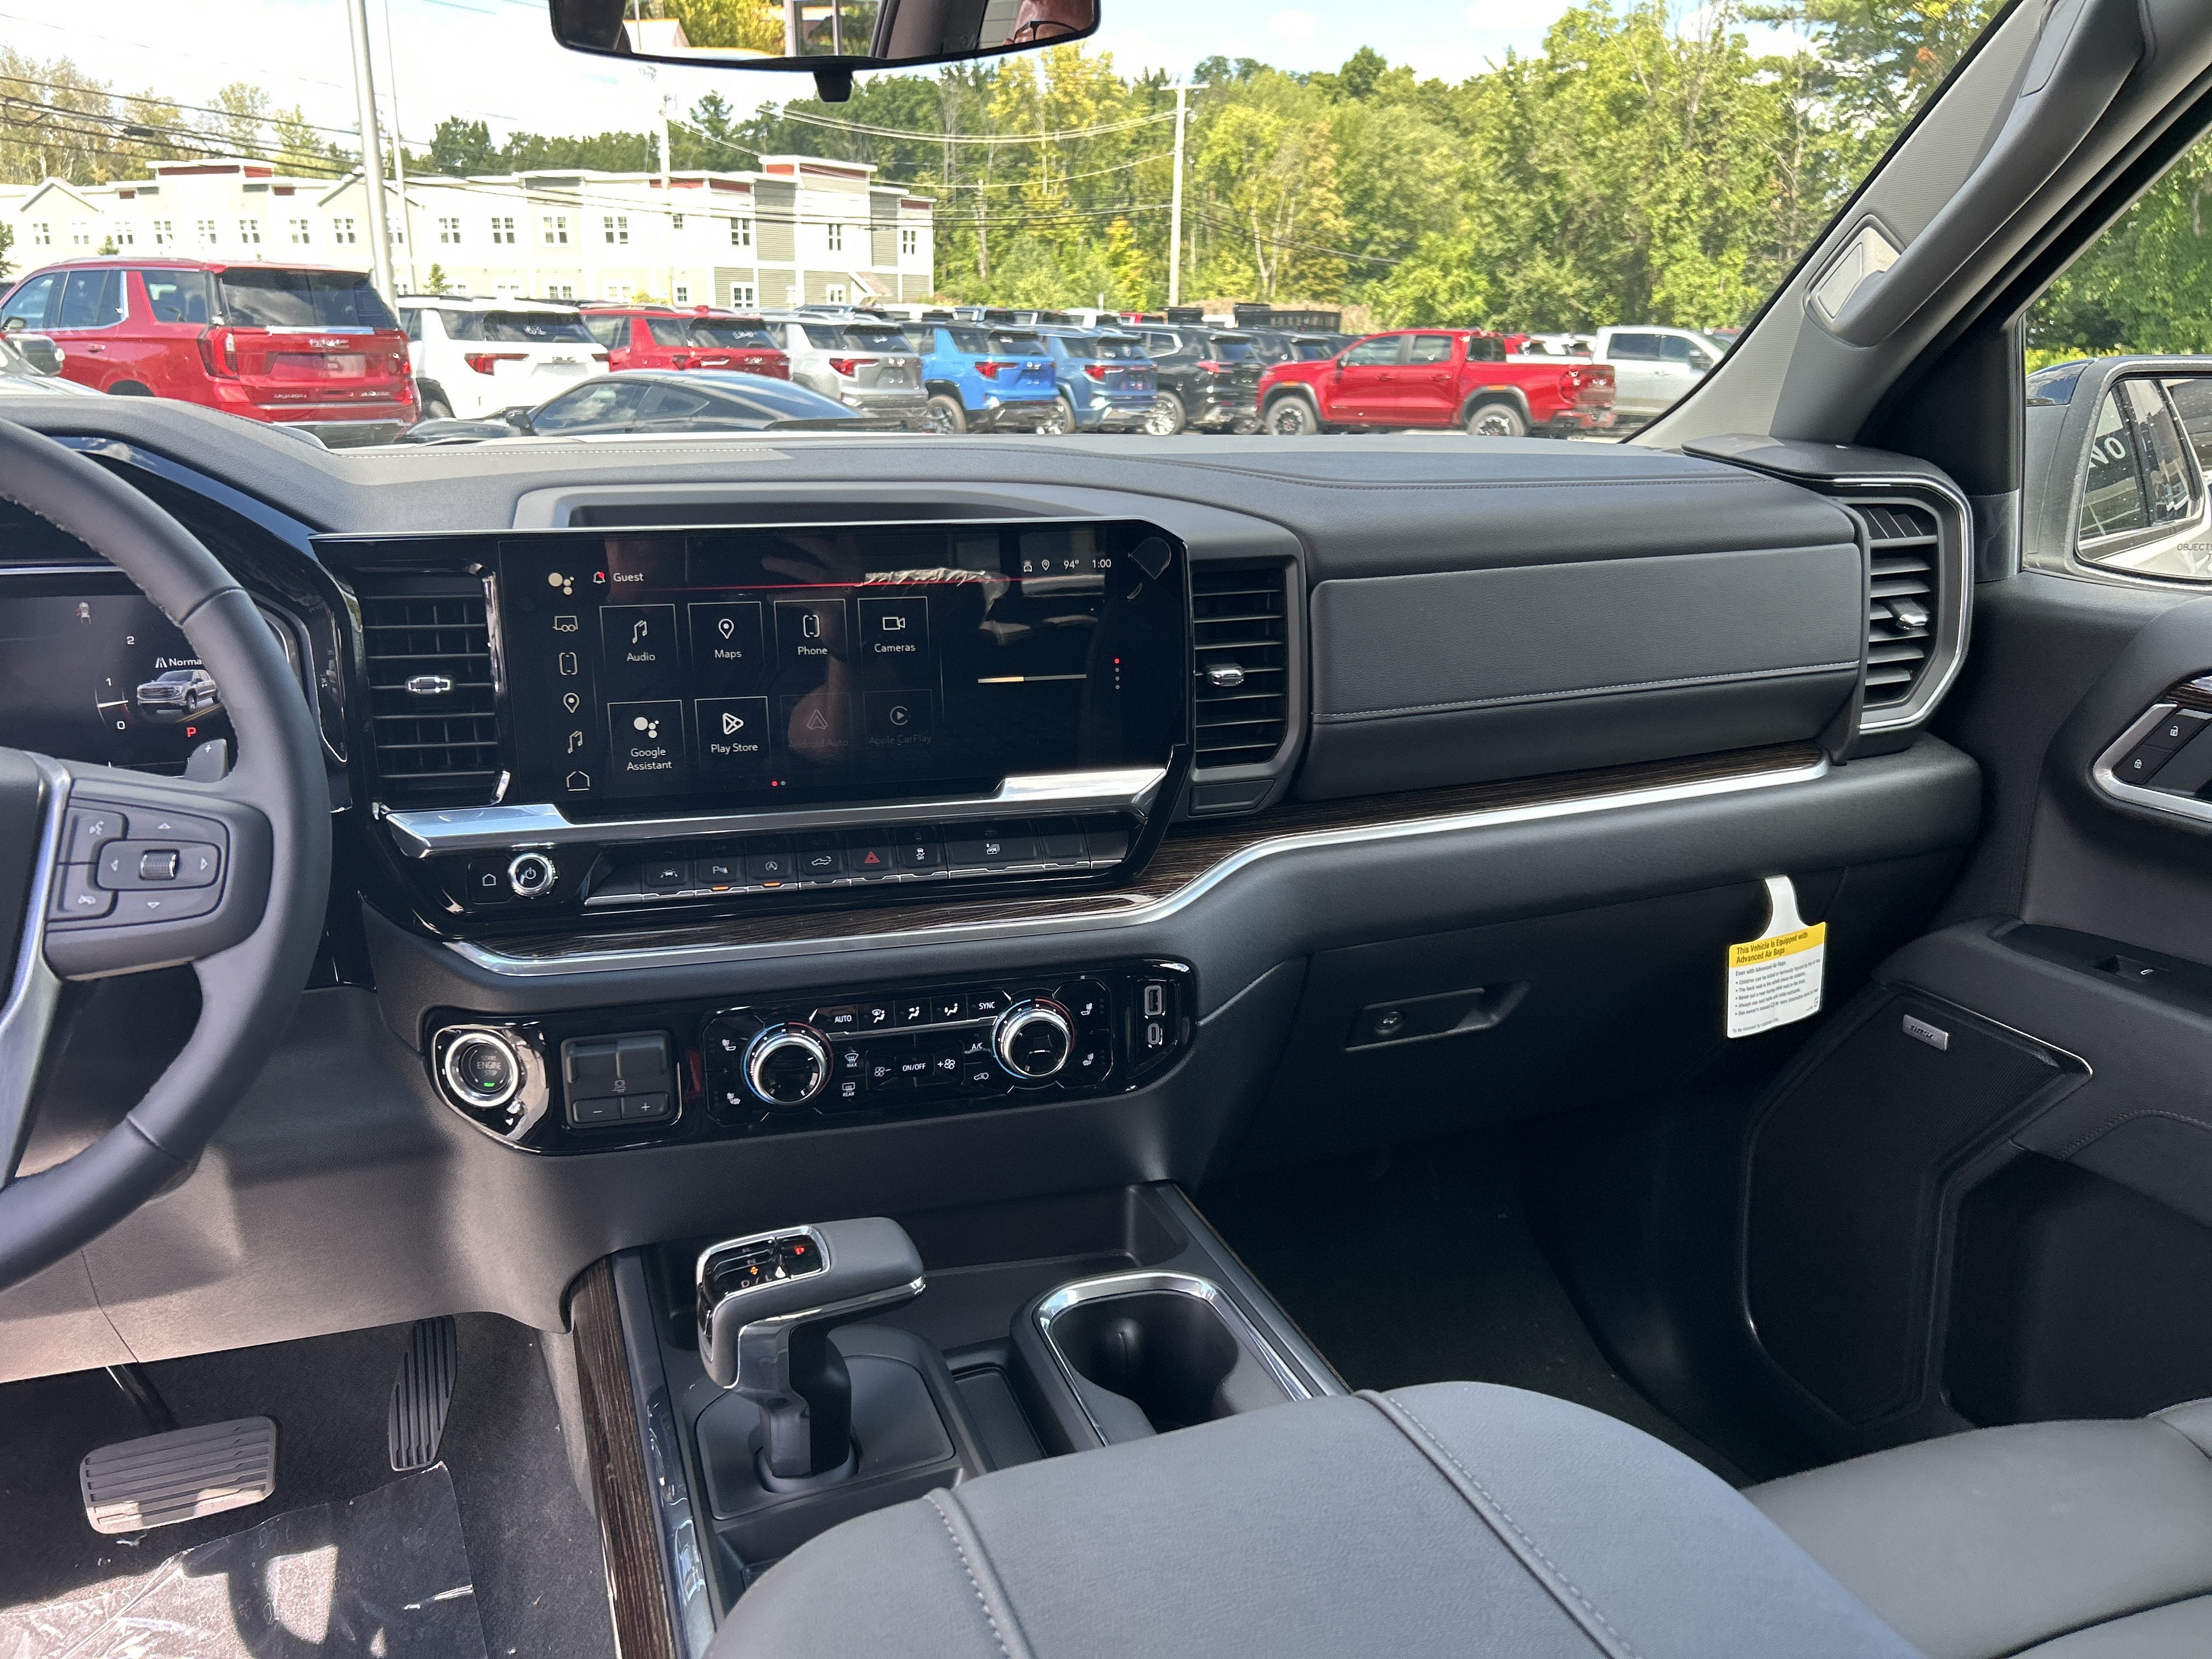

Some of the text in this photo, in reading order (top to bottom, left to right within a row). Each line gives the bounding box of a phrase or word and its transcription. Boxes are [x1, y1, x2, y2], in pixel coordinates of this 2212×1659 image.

[1092, 558, 1111, 568] 1:00
[612, 572, 644, 582] Guest
[127, 636, 135, 645] 2
[797, 645, 828, 656] Phone
[874, 643, 916, 653] Cameras
[626, 652, 656, 662] Audio
[714, 650, 742, 659] Maps
[169, 658, 202, 667] Norma
[106, 678, 112, 686] 1
[116, 720, 126, 730] 0
[186, 726, 197, 738] P
[869, 734, 932, 747] Apple CarPlay
[630, 747, 667, 759] Google
[710, 743, 758, 755] Play Store
[626, 761, 673, 771] Assistant
[1736, 946, 1749, 955] This
[1750, 941, 1769, 952] Vehicle
[1736, 952, 1764, 964] Advanced
[1764, 950, 1773, 958] Air
[834, 1001, 995, 1023] AUTO SYNC
[477, 1061, 502, 1070] ENGINE
[902, 1063, 926, 1071] ON/OFF
